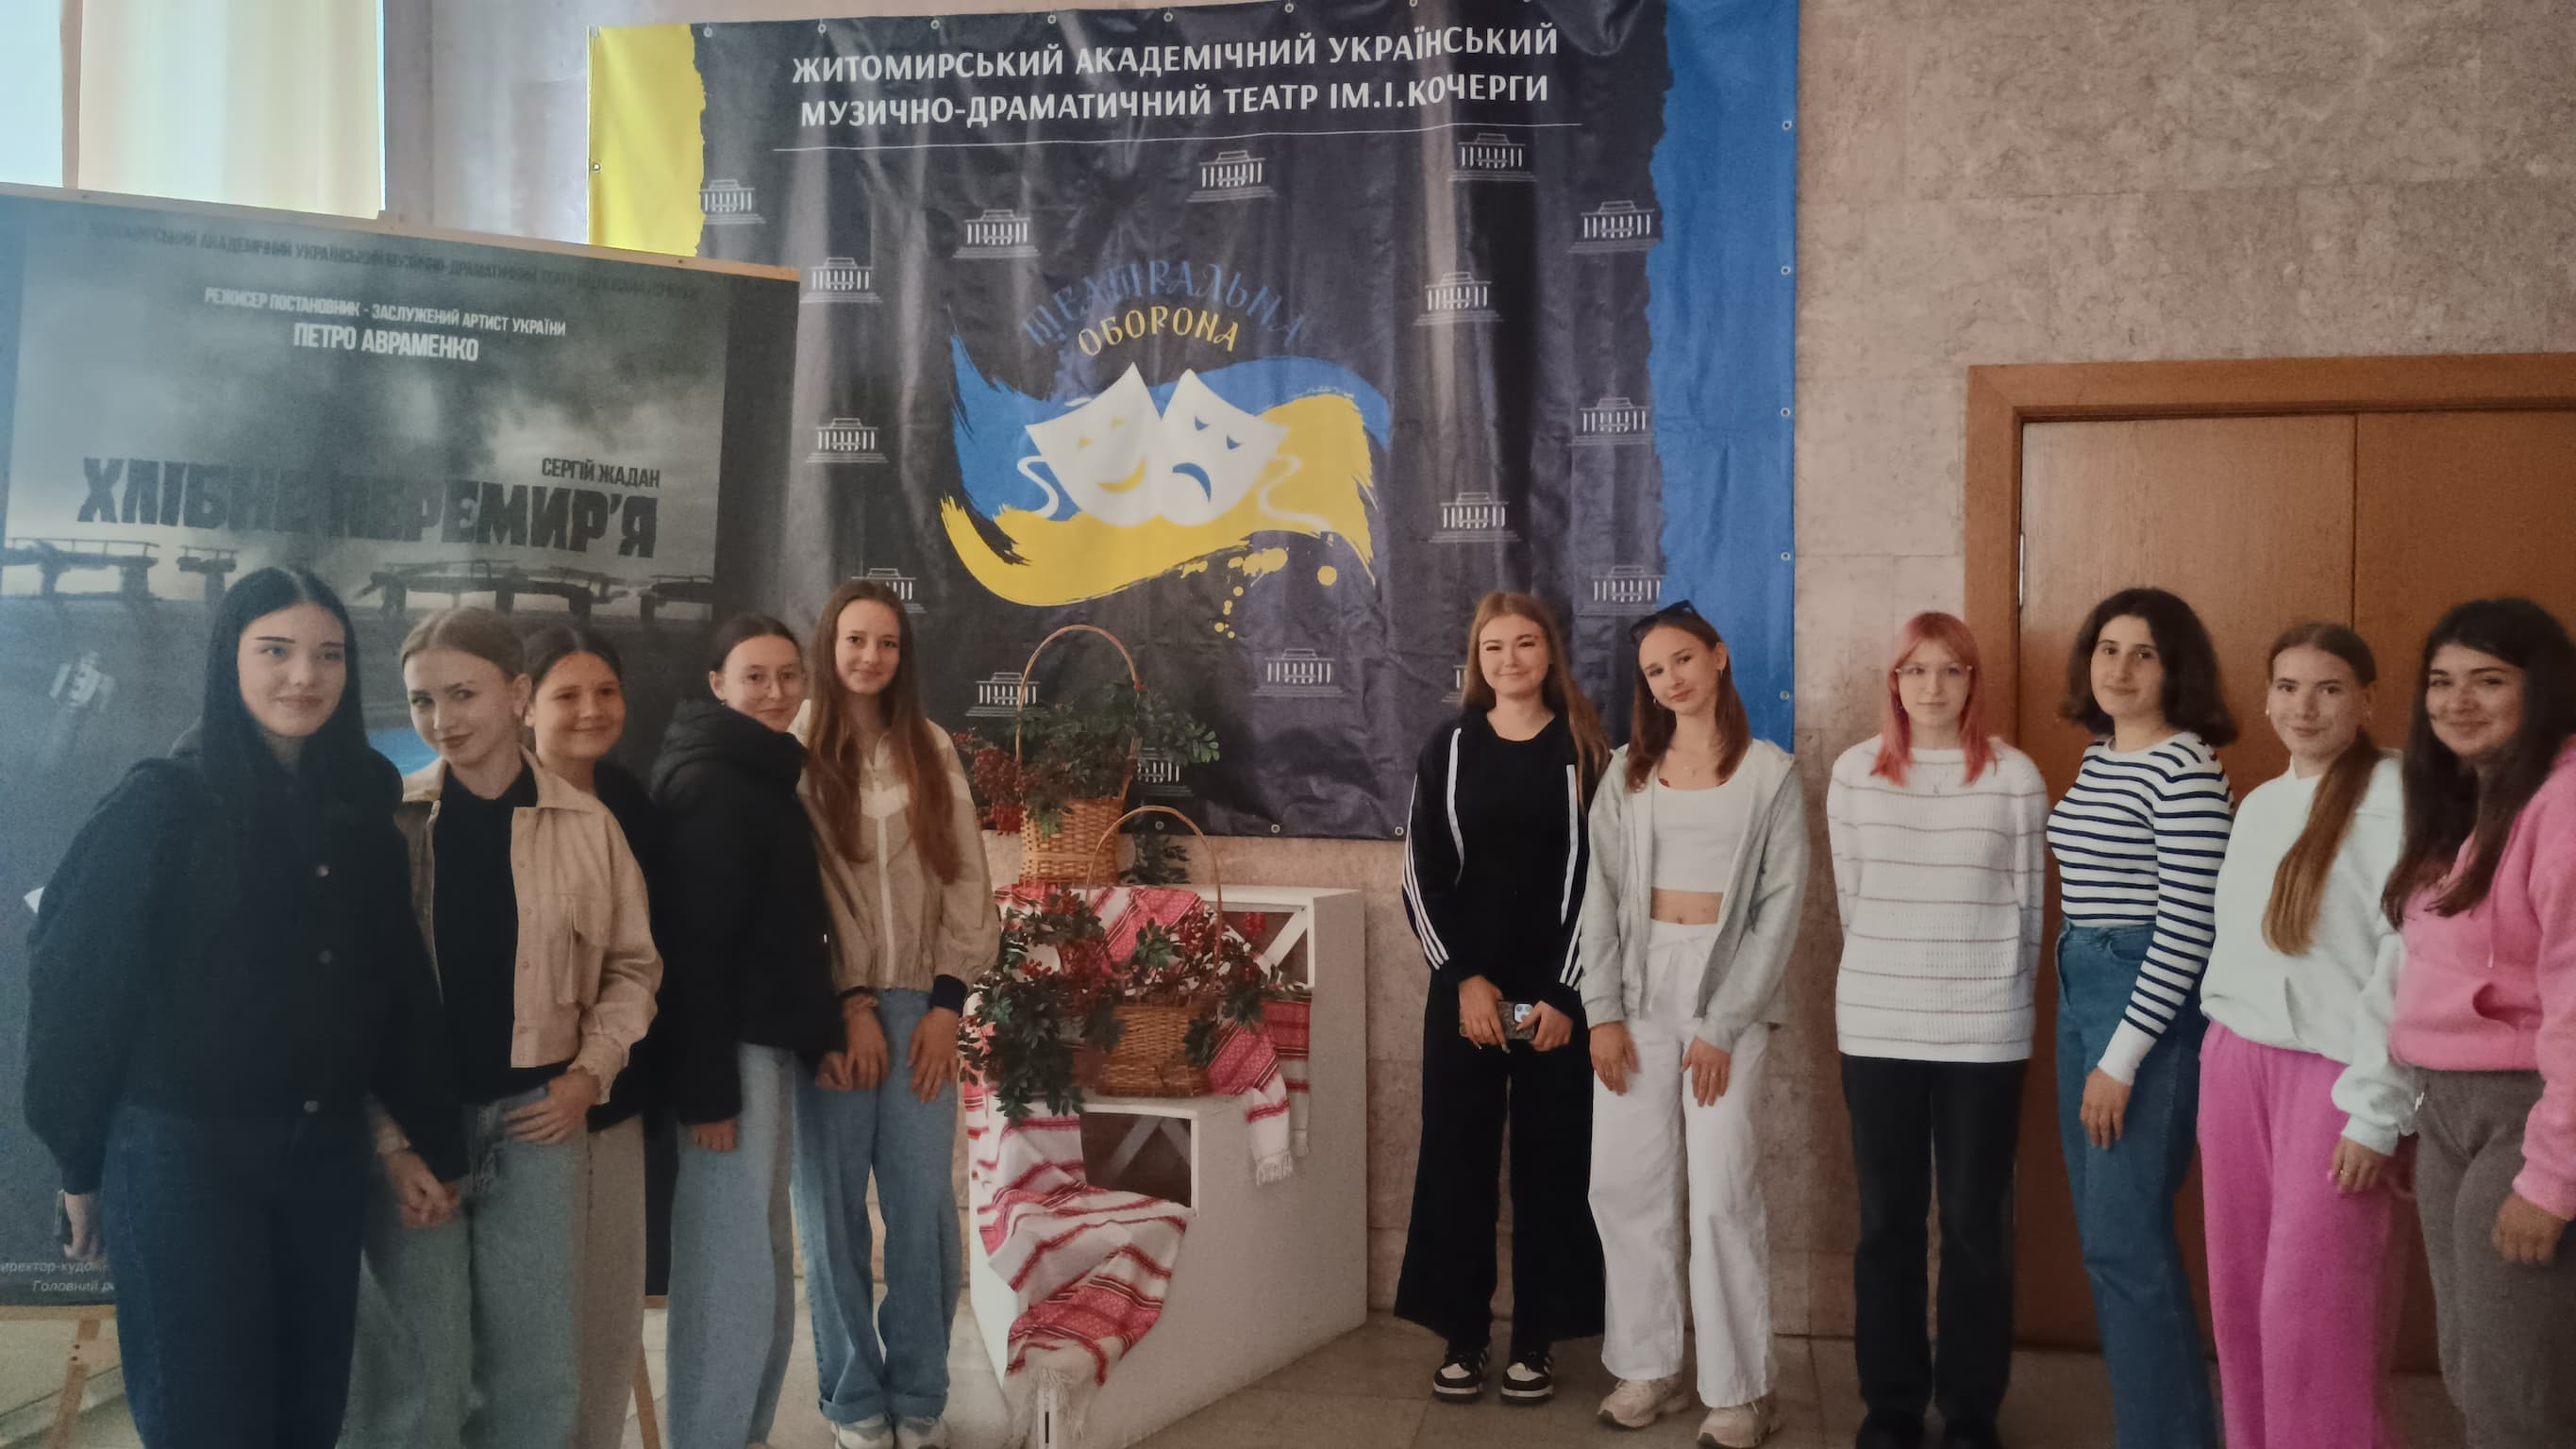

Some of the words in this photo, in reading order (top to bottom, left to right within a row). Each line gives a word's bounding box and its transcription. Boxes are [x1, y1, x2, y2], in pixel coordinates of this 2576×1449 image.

[793, 43, 1062, 83] ЖИТОМИРСЬКИЙ
[1075, 32, 1315, 77] АКАДЕМІЧНИЙ
[1329, 22, 1557, 63] УКРАЇНСЬКИЙ
[801, 84, 1211, 128] МУЗИЧНО-ДРАМАТИЧНИЙ
[1223, 84, 1318, 114] ТЕАТР
[1330, 75, 1548, 109] ІМ.І.КОЧЕРГИ
[205, 287, 268, 309] РЕЖИСЕР
[270, 293, 360, 318] ПОСТАНОВНИК
[372, 304, 460, 326] ЗАСЛУЖЕНИЙ
[462, 313, 510, 333] АРТИСТ
[512, 319, 566, 337] УКРАЇНИ
[1078, 306, 1239, 357] ОБОРОНА
[293, 322, 357, 350] ПЕТРО
[360, 328, 479, 362] АВРАМЕНКО
[541, 457, 595, 483] СЕРГІЙ
[597, 463, 661, 489] ЖАДАН
